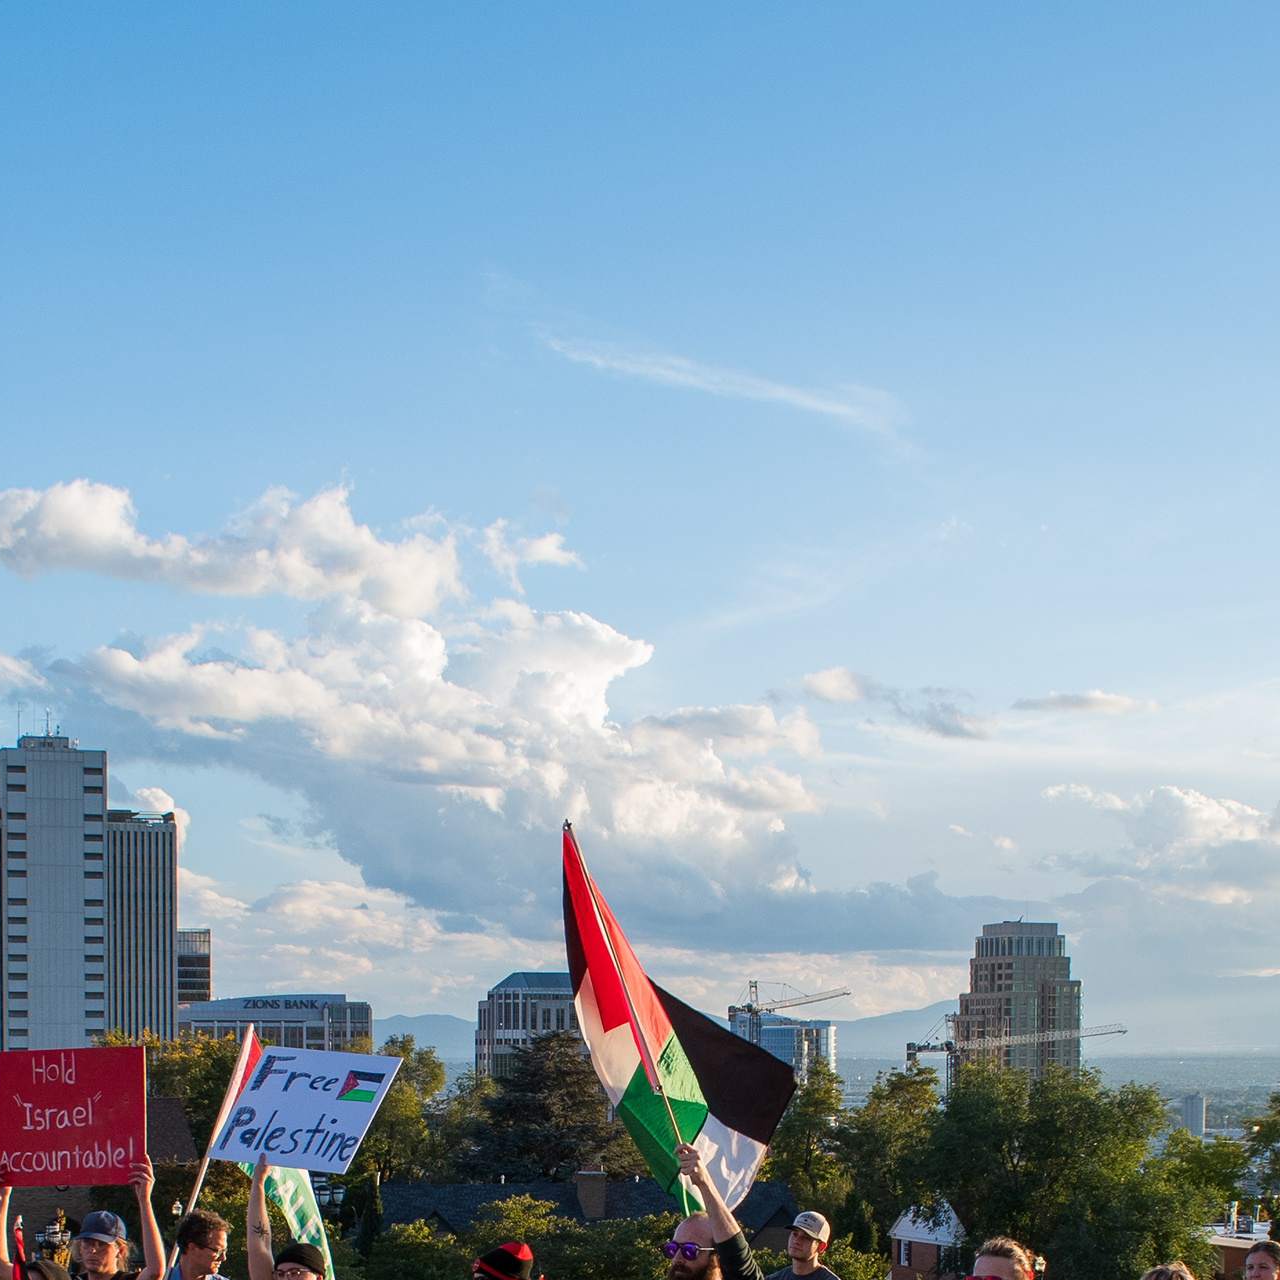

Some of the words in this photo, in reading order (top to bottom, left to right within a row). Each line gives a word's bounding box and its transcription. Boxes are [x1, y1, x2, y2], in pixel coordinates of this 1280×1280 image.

[243, 999, 281, 1010] ZIONS
[284, 999, 319, 1010] BANK
[31, 1051, 76, 1085] Hold
[250, 1054, 340, 1092] Free
[220, 1105, 360, 1162] Palestine
